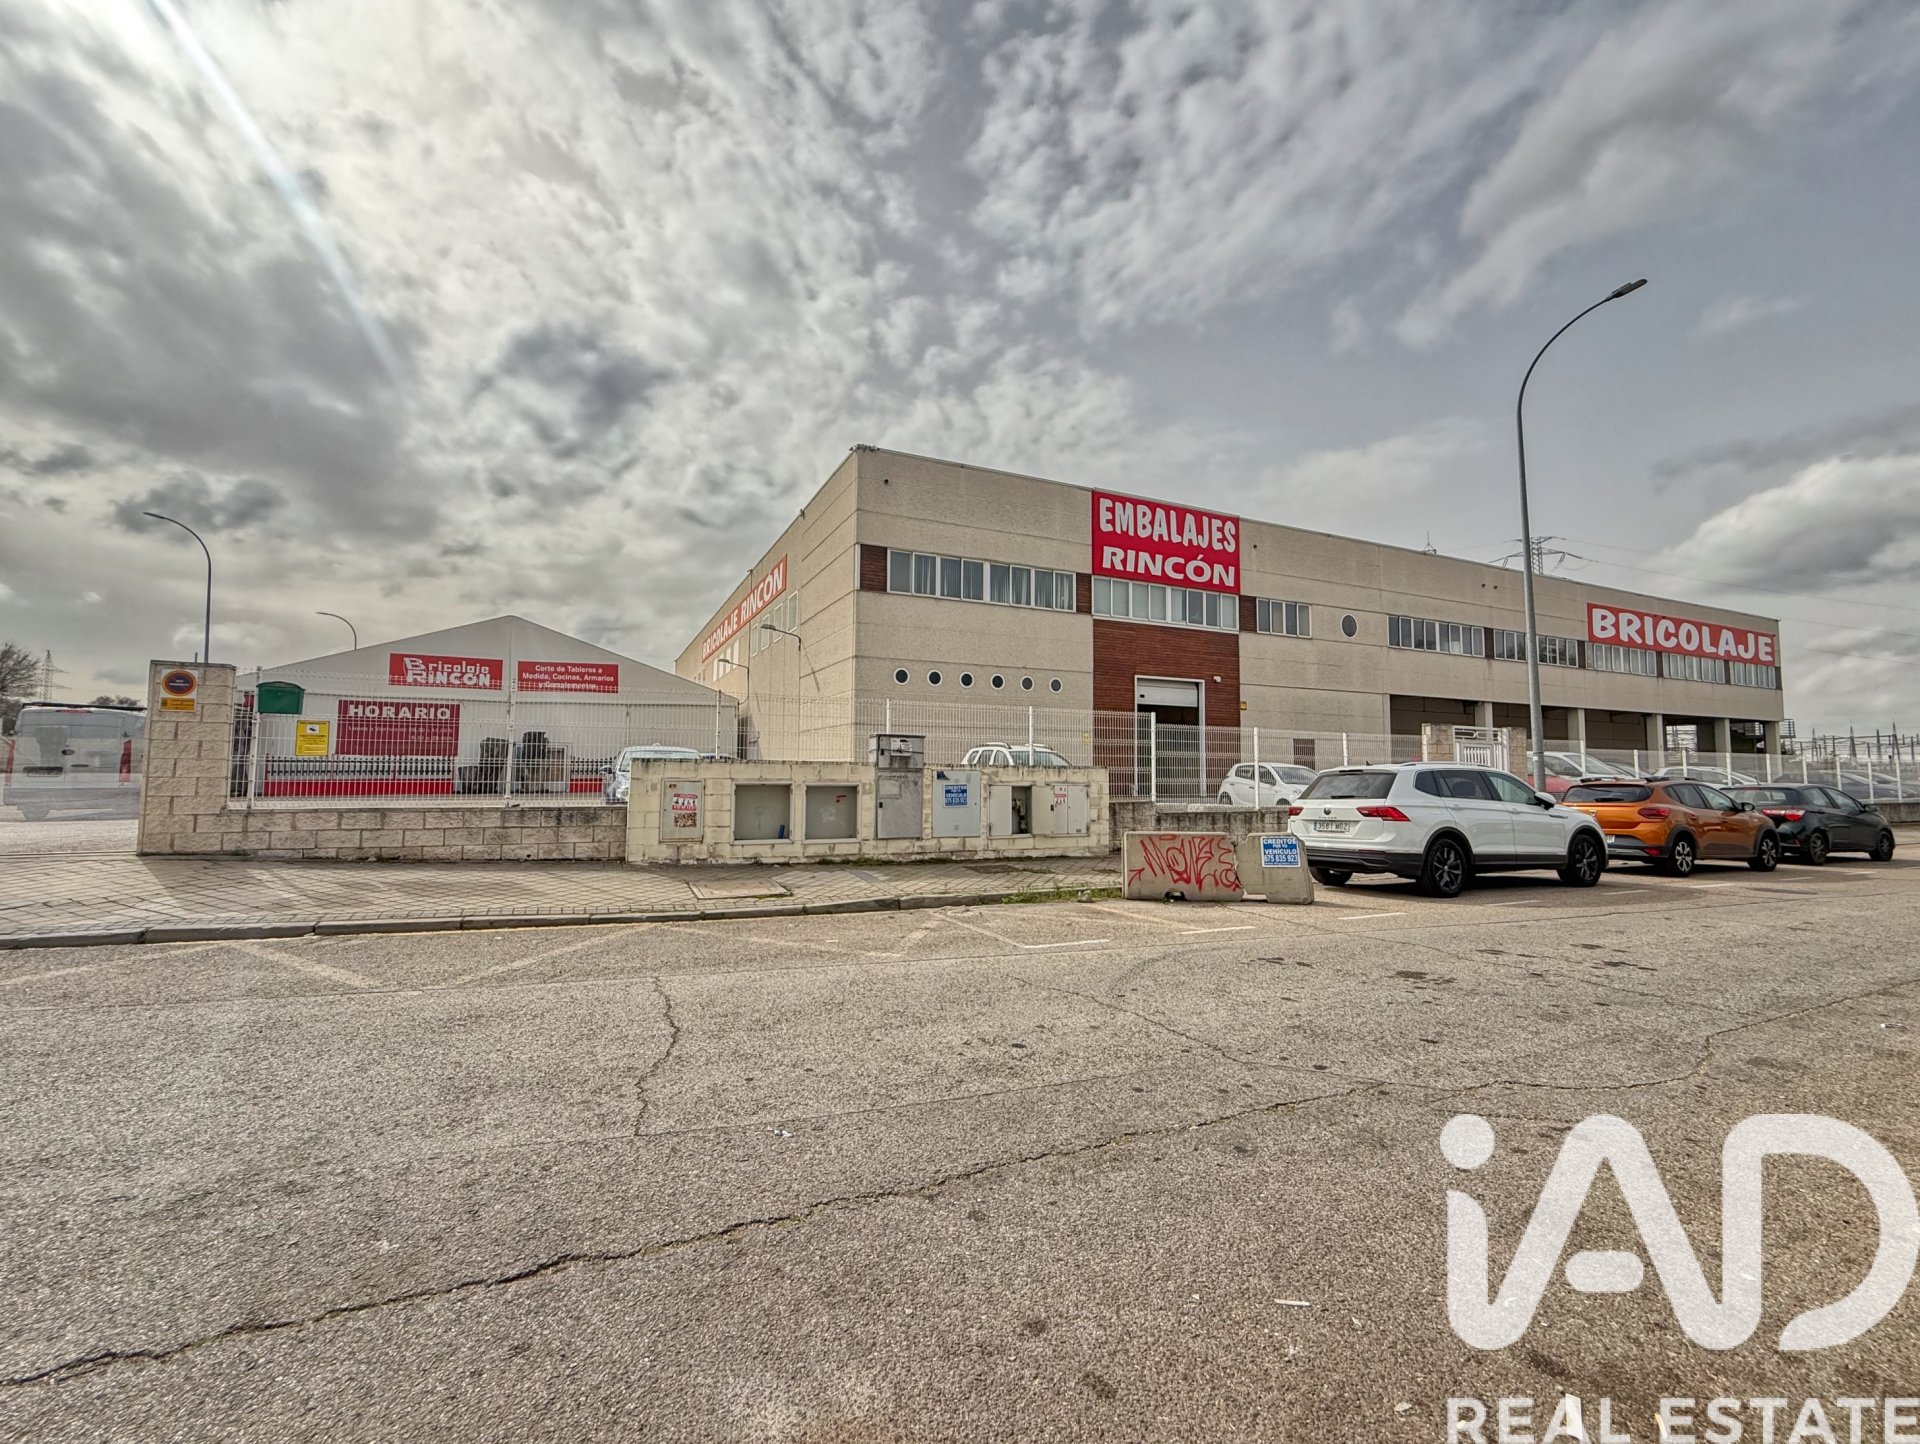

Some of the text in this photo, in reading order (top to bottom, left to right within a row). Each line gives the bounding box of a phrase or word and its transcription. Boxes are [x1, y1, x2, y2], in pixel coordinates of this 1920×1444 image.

[1099, 497, 1236, 553] EMBALAJES
[1102, 545, 1236, 587] RINCÓN
[702, 608, 739, 660] BRICOLAJE
[1592, 608, 1773, 661] BRICOLAJE
[522, 672, 614, 682] Medida, Cocinas, Armarios
[567, 665, 597, 673] Tableros
[348, 704, 451, 719] HORARIO
